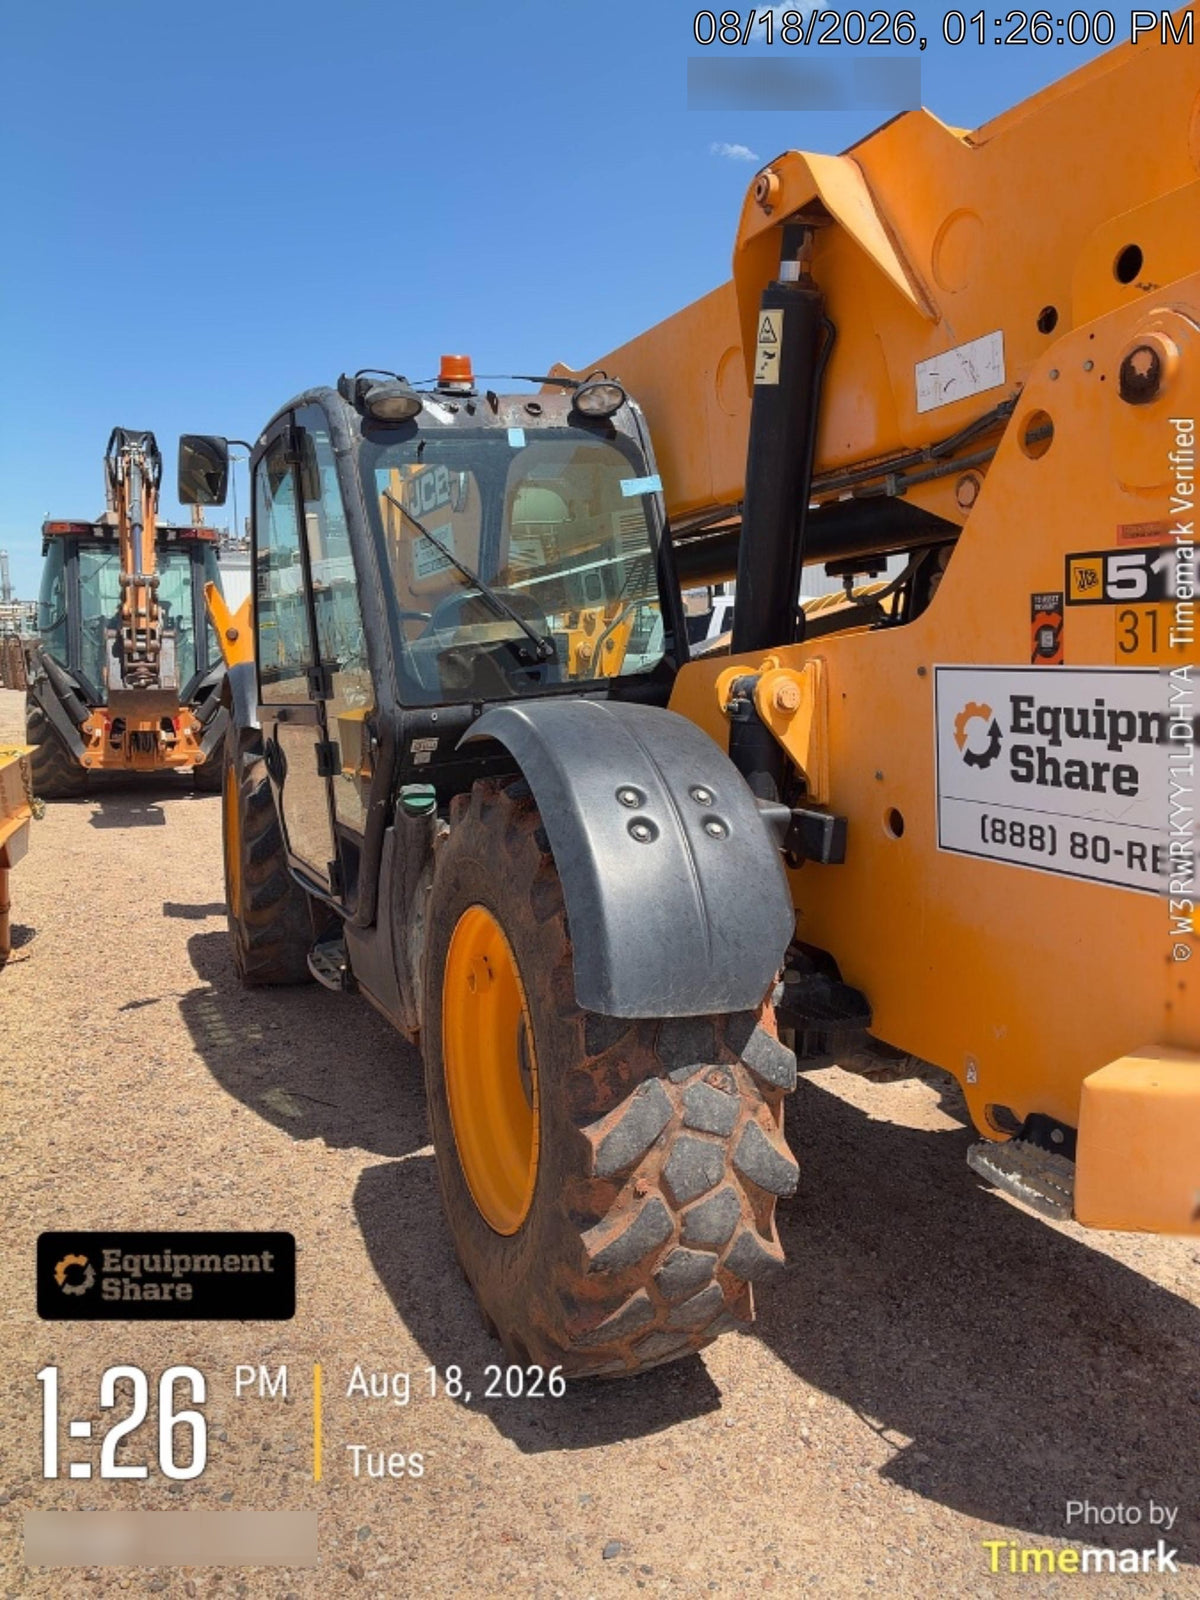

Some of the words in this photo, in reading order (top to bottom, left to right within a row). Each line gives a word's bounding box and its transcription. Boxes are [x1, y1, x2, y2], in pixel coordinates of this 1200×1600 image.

[1106, 553, 1200, 601] 51
[1010, 744, 1139, 797] Share
[980, 814, 1057, 856] (888)
